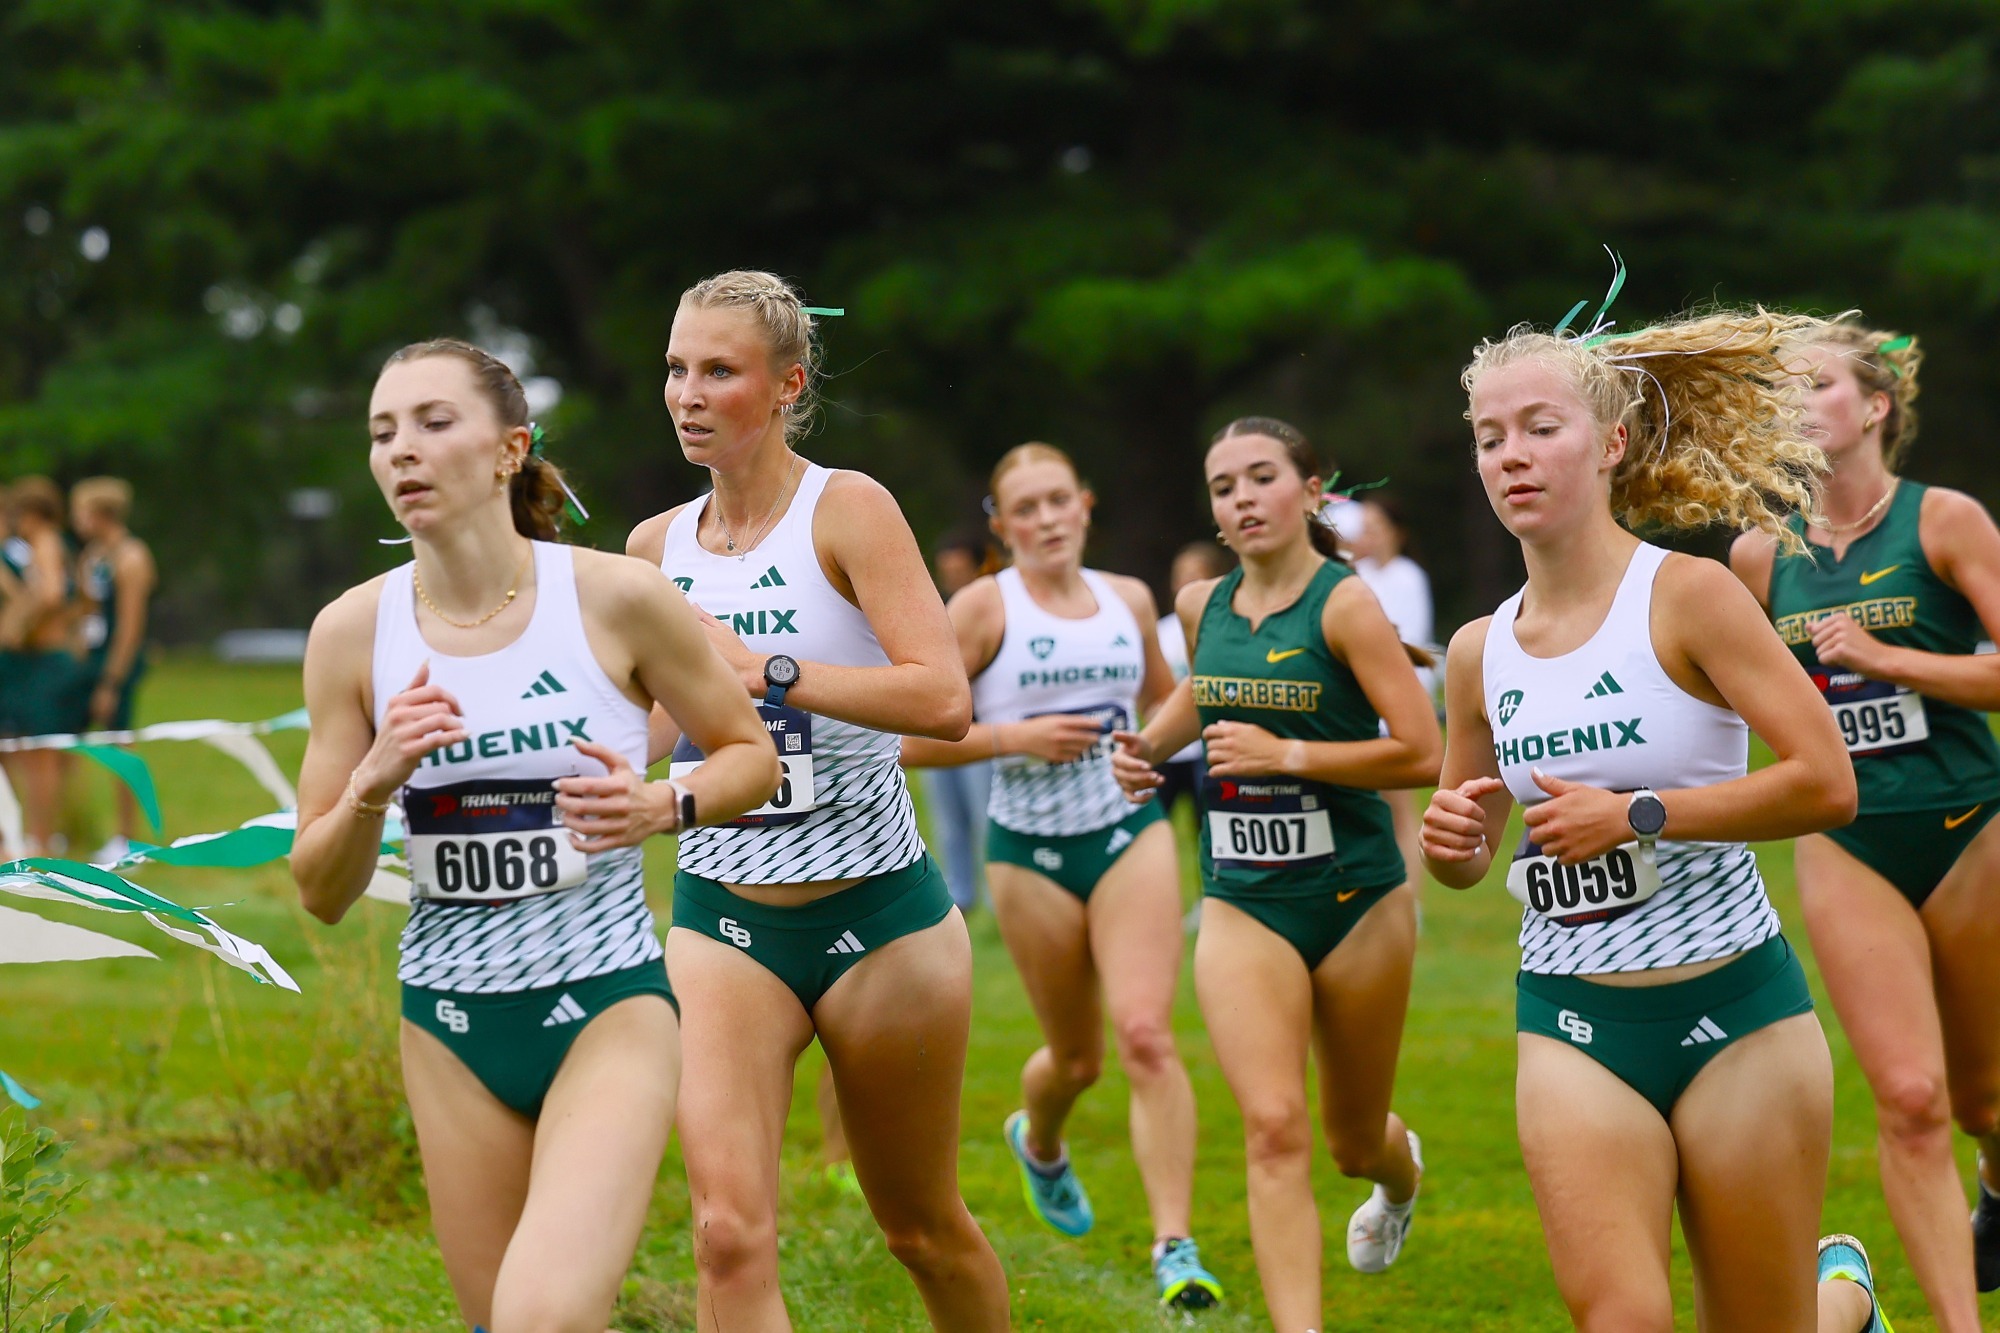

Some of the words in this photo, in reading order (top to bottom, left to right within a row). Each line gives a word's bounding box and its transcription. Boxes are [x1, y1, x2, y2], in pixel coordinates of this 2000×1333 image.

[1838, 702, 1906, 746] 995
[461, 791, 554, 808] PRIMETIME
[1238, 784, 1302, 796] PRIMETIME
[1229, 818, 1307, 855] 6007
[435, 836, 558, 893] 6068
[1526, 850, 1637, 913] 6059
[719, 917, 752, 948] GB
[436, 999, 469, 1033] GB
[1558, 1009, 1593, 1044] GB
